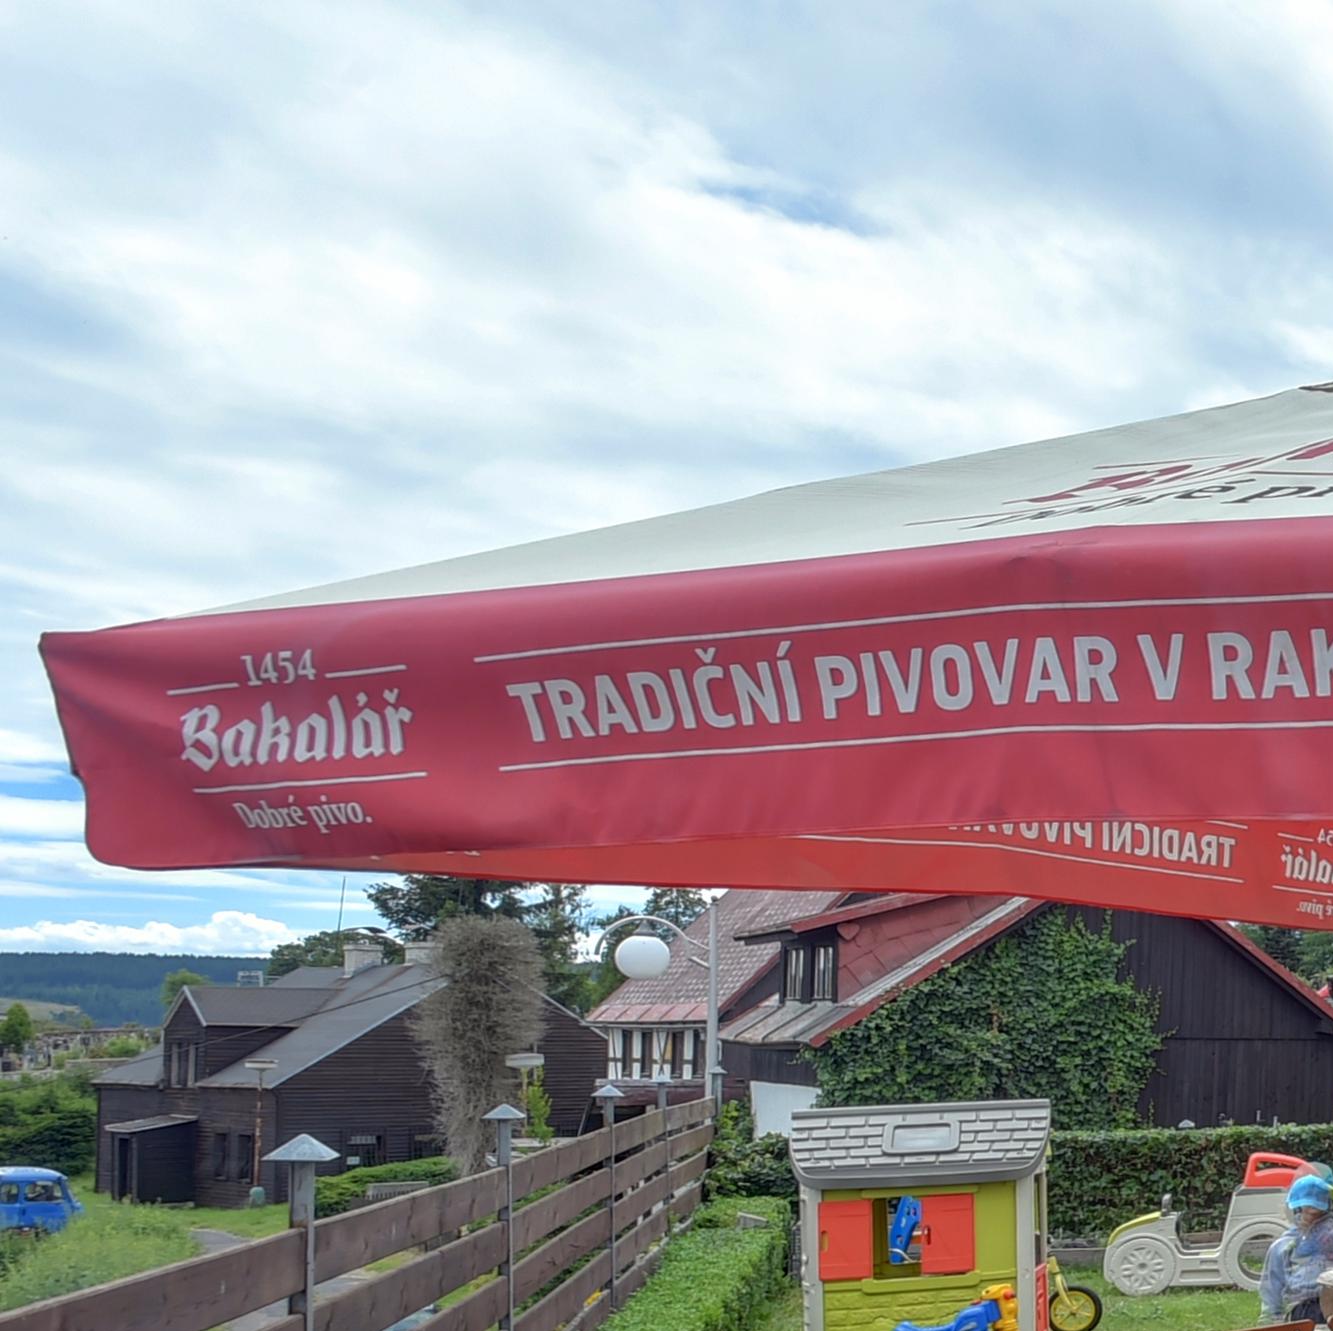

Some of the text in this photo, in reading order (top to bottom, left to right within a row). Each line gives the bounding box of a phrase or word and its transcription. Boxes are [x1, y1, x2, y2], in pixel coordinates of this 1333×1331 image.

[240, 649, 316, 686] 1454
[506, 640, 802, 742] TRADIČNÍ
[814, 635, 1119, 719] PIVOVAR
[1136, 633, 1184, 702] V
[180, 688, 413, 772] Bakalář
[233, 794, 374, 833] Dobré pivo.
